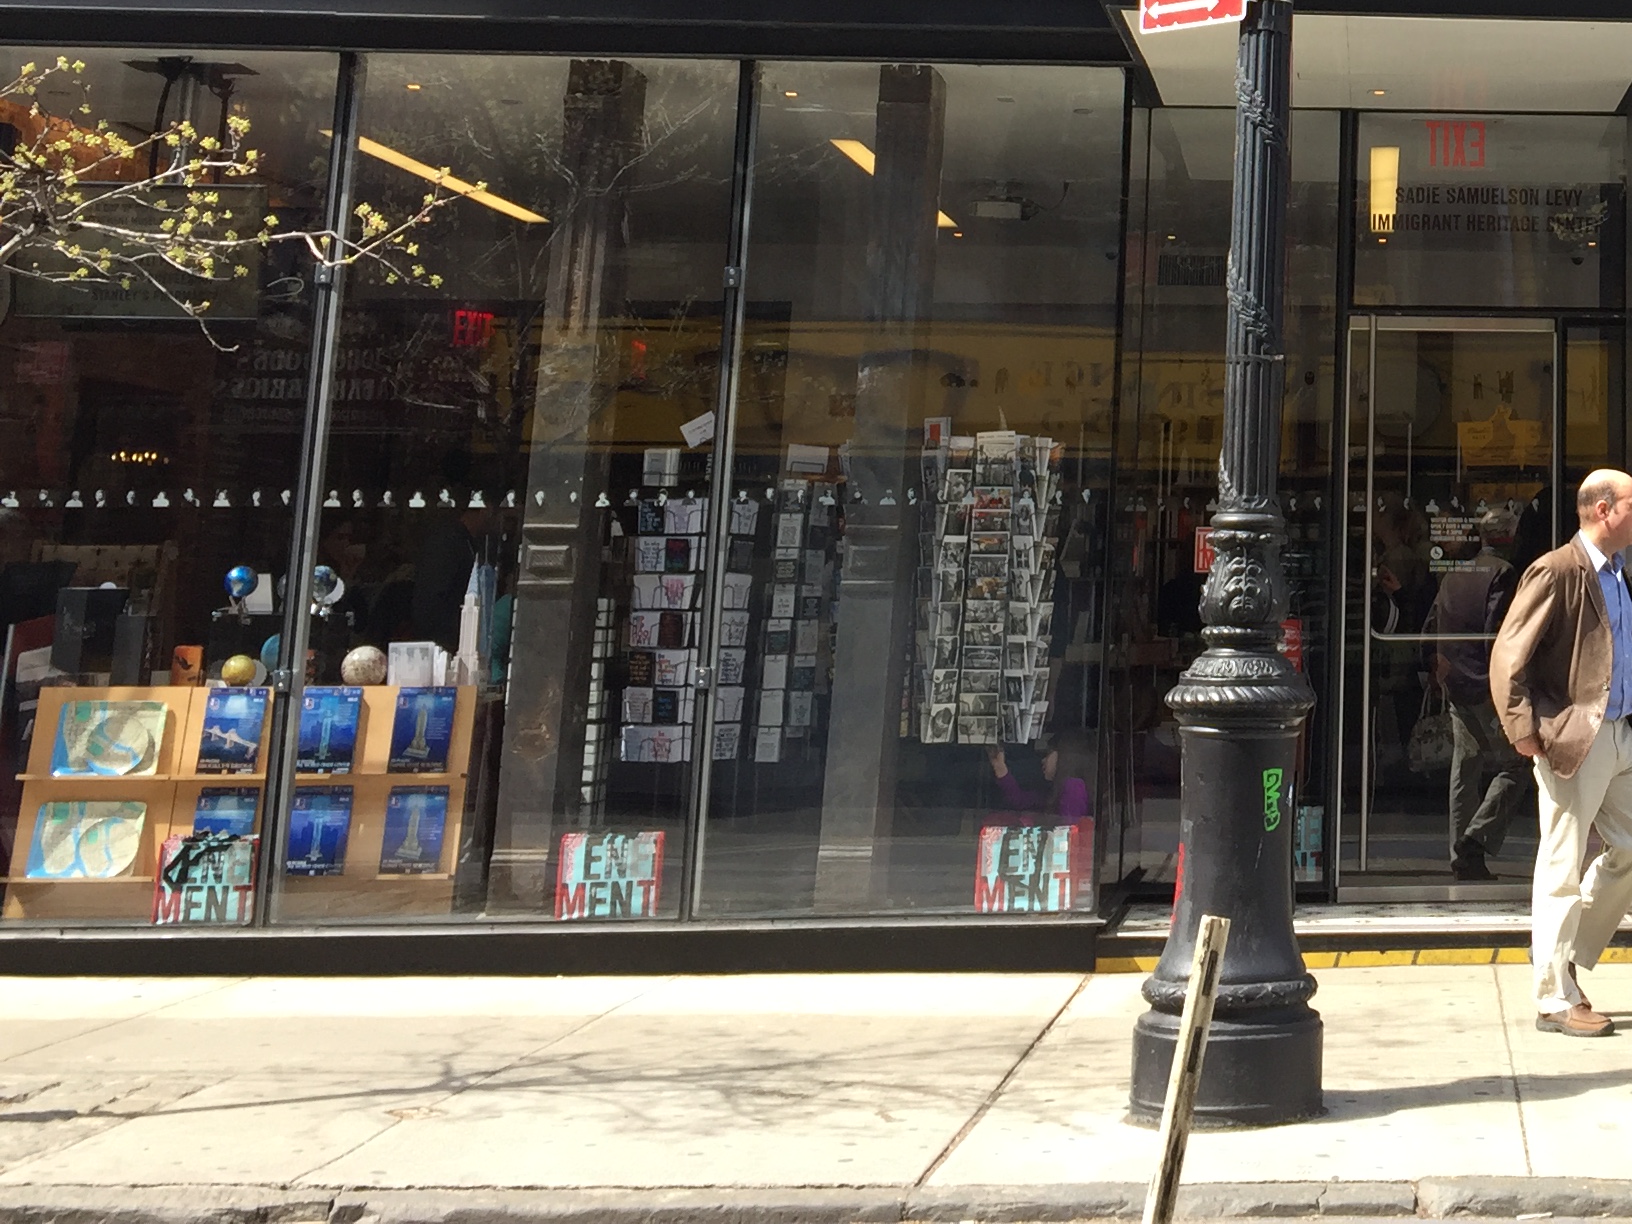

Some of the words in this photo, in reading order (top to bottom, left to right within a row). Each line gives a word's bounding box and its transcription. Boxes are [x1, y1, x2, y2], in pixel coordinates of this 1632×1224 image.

[1395, 187, 1440, 204] SADIE
[1446, 187, 1540, 206] SAMUELSON
[1546, 189, 1583, 207] LEVY
[1372, 213, 1462, 231] IMMIGRANT
[1466, 213, 1539, 232] HERITAGE
[158, 884, 252, 923] MENT
[558, 879, 656, 918] MENT
[978, 872, 1070, 912] MENT
